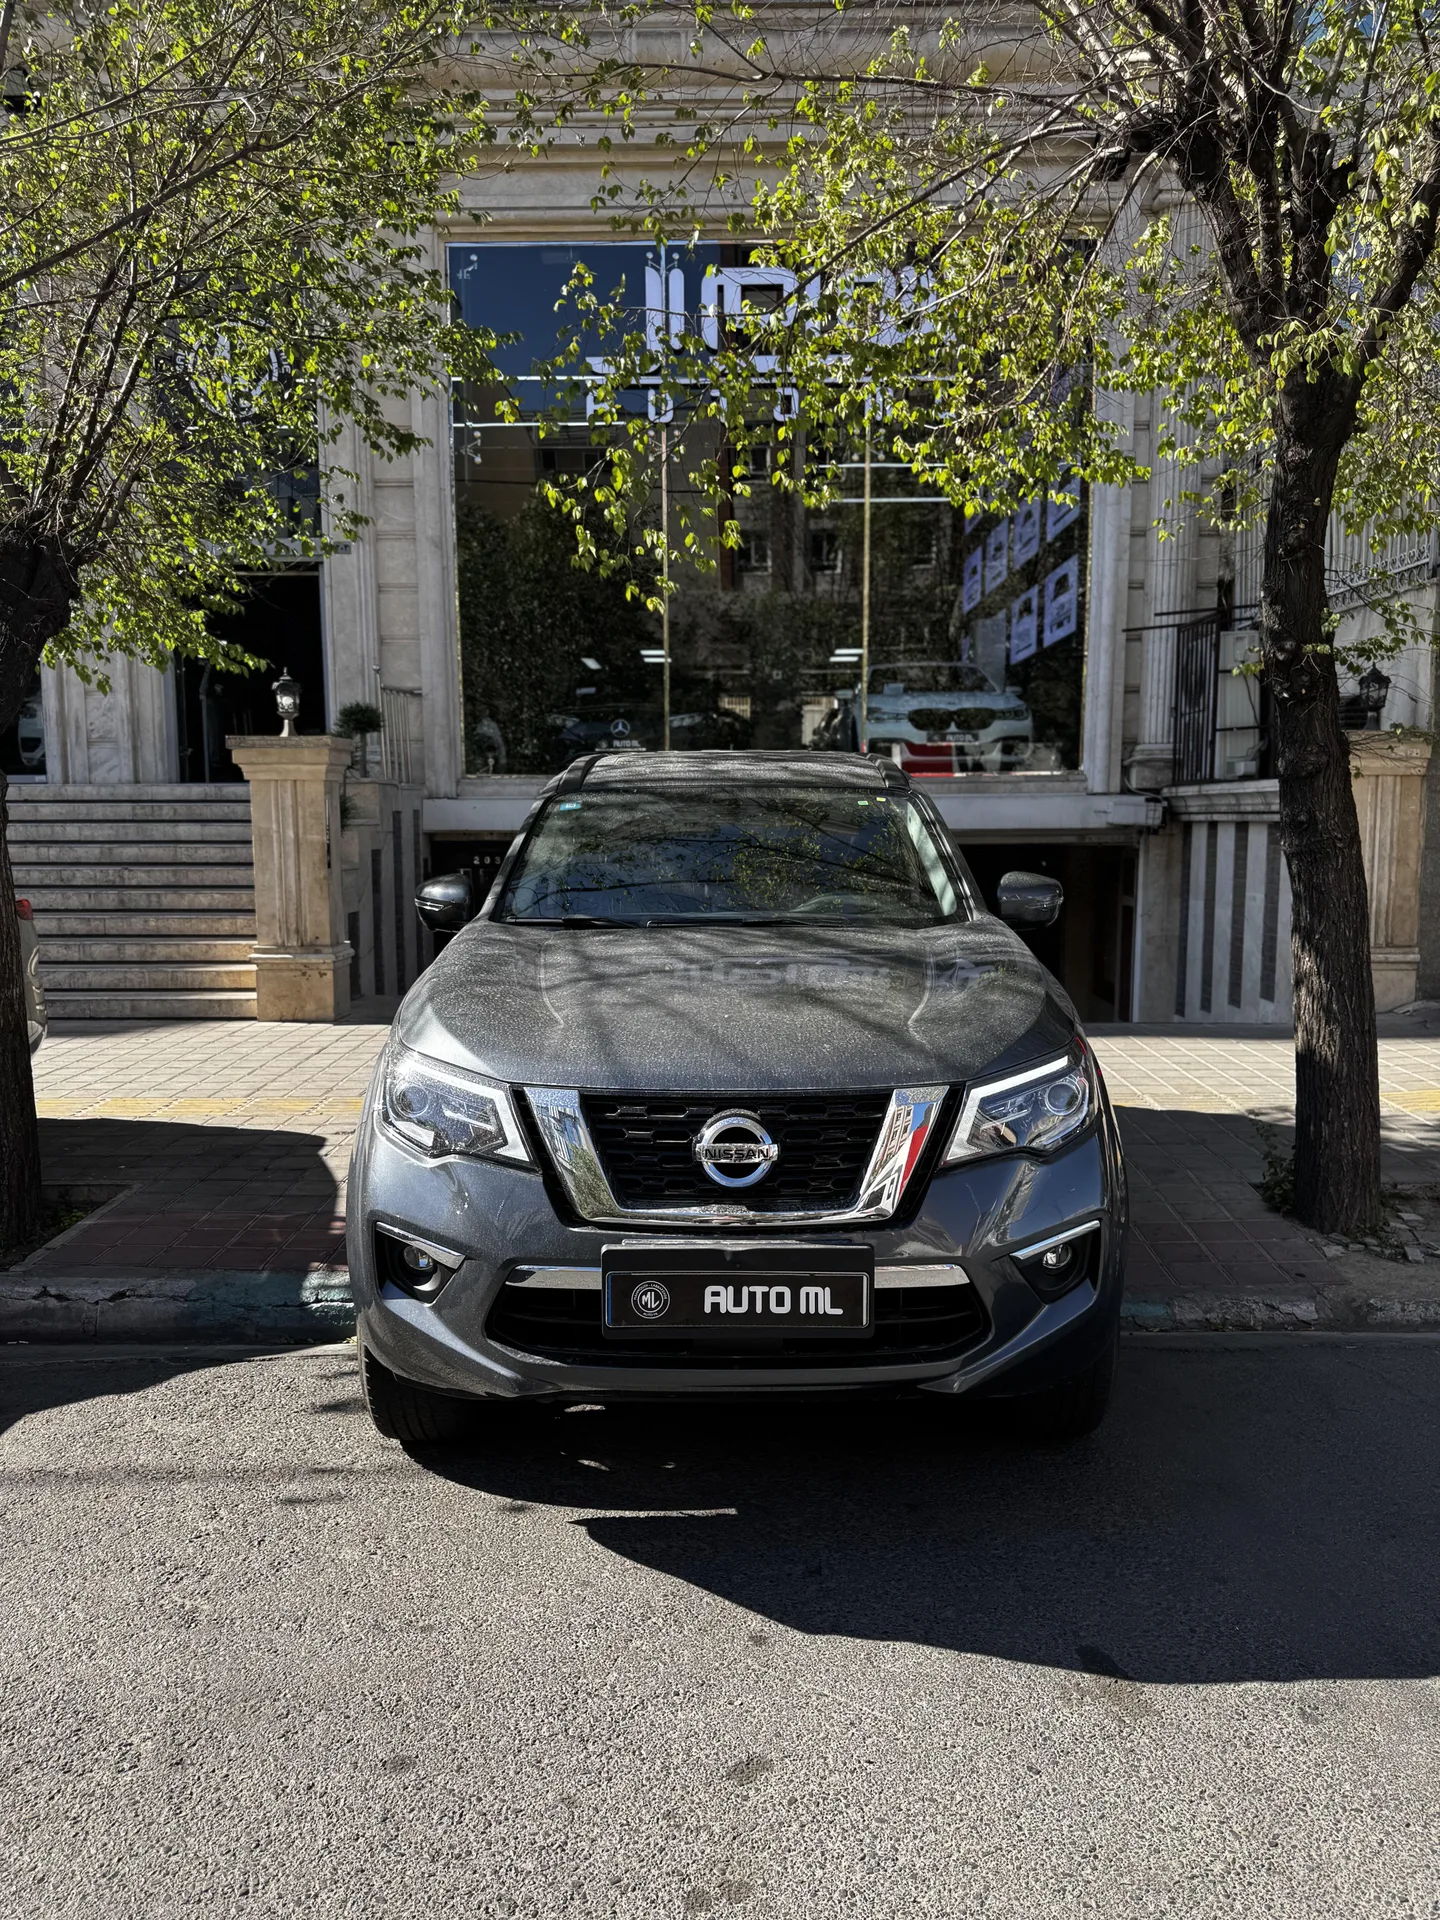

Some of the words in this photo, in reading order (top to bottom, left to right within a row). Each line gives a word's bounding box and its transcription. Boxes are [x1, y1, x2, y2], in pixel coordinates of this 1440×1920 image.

[705, 1148, 769, 1159] NISSAN
[641, 1291, 660, 1309] ML
[704, 1285, 791, 1314] AUTO
[800, 1286, 844, 1315] ML
